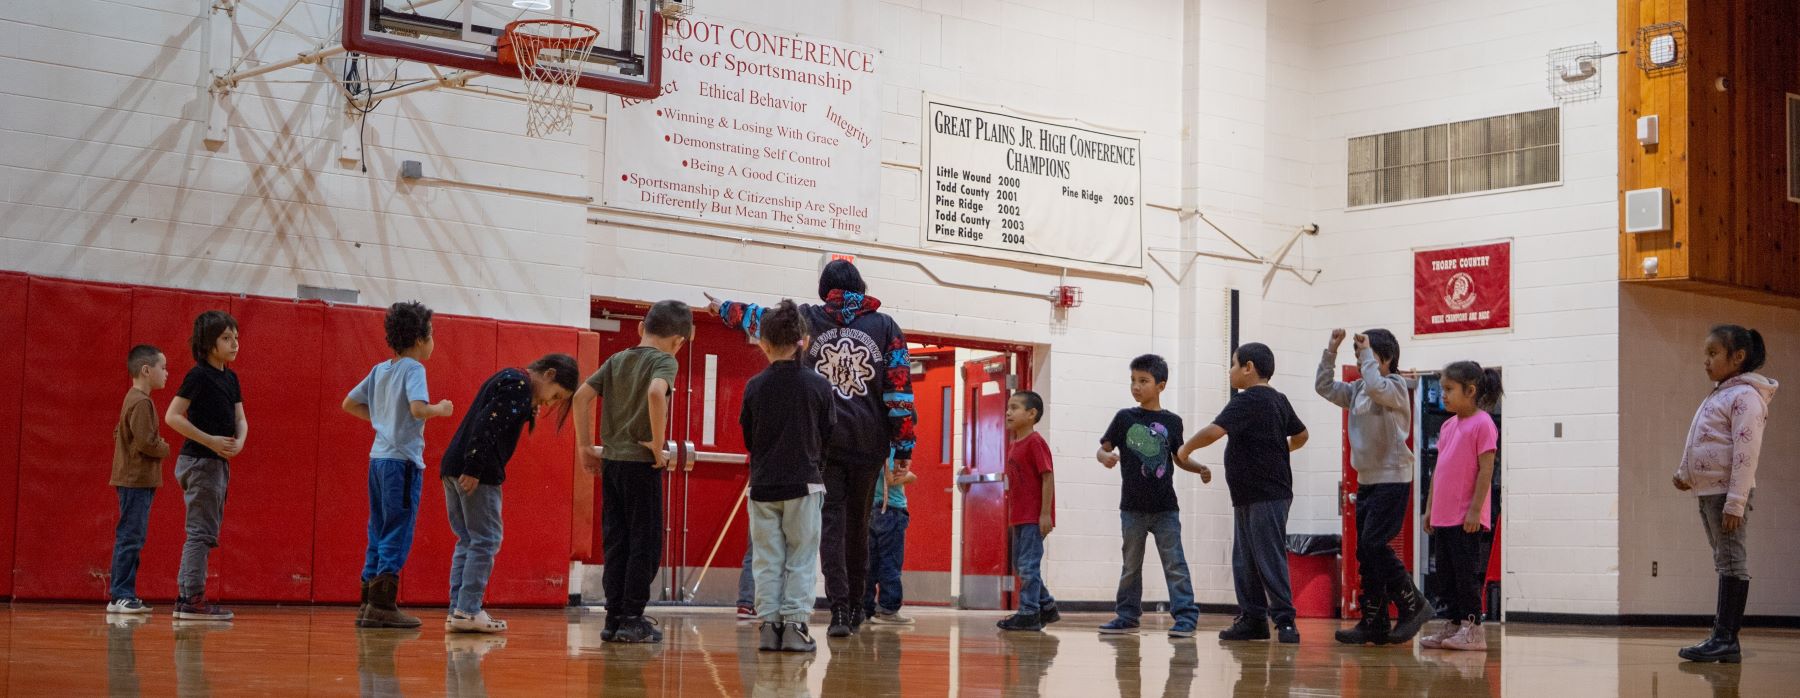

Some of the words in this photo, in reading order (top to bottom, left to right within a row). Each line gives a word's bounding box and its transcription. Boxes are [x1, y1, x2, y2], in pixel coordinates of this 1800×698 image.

[730, 28, 875, 73] CONFERENCE
[662, 45, 693, 63] ode
[700, 52, 722, 68] of
[725, 53, 852, 95] Sportsmanship
[699, 81, 745, 103] Ethical
[750, 90, 808, 113] Behavior
[664, 107, 715, 128] Winning
[718, 116, 729, 128] &
[733, 119, 773, 138] Losing
[777, 125, 803, 140] With
[806, 131, 840, 147] Grace
[826, 105, 872, 148] Integrity
[673, 133, 760, 159] Demonstrating
[763, 147, 787, 161] Self
[789, 151, 831, 168] Control
[690, 158, 725, 176] Being
[728, 165, 738, 176] A
[742, 166, 773, 182] Good
[776, 171, 817, 188] Citizen
[936, 166, 959, 179] Little
[962, 170, 992, 184] Wound
[998, 175, 1020, 188] 2000
[630, 173, 720, 199] Sportsmanship
[723, 187, 734, 199] &
[738, 190, 802, 211] Citizenship
[805, 200, 825, 212] Are
[828, 203, 868, 219] Spelled
[936, 180, 957, 193] Todd
[960, 184, 990, 200] County
[996, 189, 1018, 202] 2001
[936, 195, 955, 207] Pine
[958, 198, 984, 213] Ridge
[997, 203, 1020, 216] 2002
[1062, 186, 1079, 198] Pine
[1081, 189, 1103, 205] Ridge
[1113, 194, 1135, 206] 2005
[640, 190, 708, 214] Differently
[711, 201, 732, 215] But
[735, 205, 768, 220] Mean
[772, 210, 793, 223] The
[797, 214, 827, 228] Same
[829, 218, 861, 235] Thing
[936, 209, 957, 222] Todd
[960, 213, 991, 229] County
[1001, 218, 1025, 231] 2003
[935, 224, 955, 236] Pine
[958, 227, 984, 241] Ridge
[1001, 232, 1025, 245] 2004
[1432, 259, 1457, 271] THORPE
[1459, 255, 1490, 268] COUNTRY
